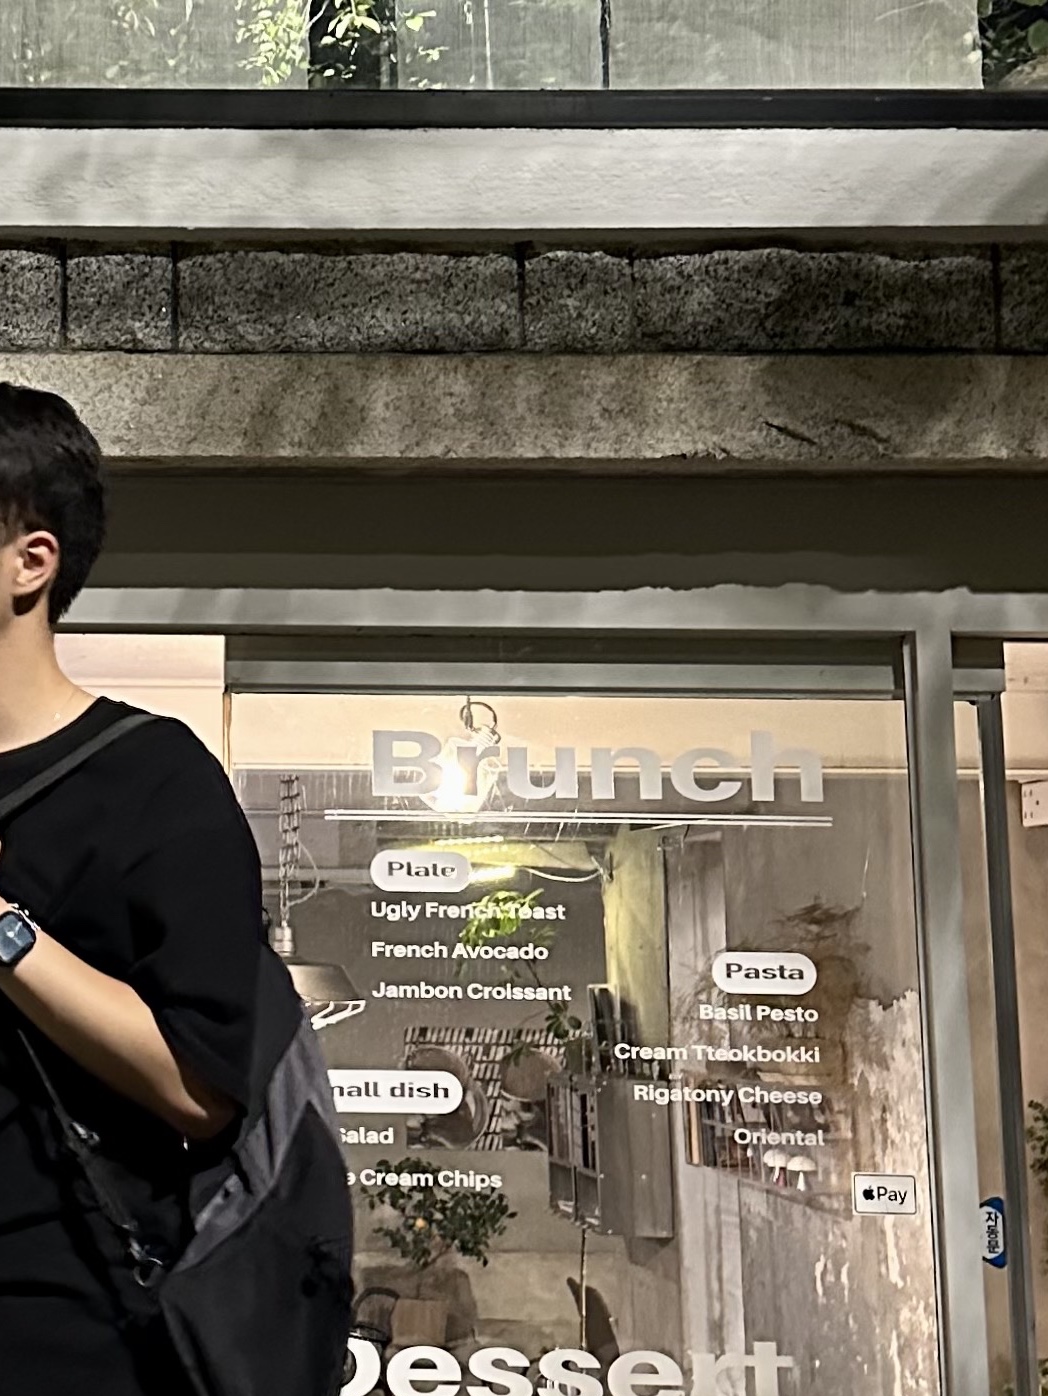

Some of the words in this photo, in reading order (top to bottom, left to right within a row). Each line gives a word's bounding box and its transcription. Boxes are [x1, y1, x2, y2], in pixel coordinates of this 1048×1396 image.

[372, 730, 824, 802] Brunch
[387, 860, 456, 878] Plate
[371, 901, 421, 921] Ugly
[425, 902, 501, 919] French
[508, 903, 566, 920] Toast
[371, 942, 448, 959] French
[452, 943, 549, 960] Avocado
[725, 963, 804, 980] Pasta
[371, 982, 463, 999] Jambon
[466, 983, 572, 1001] Croissant
[699, 1004, 752, 1020] Basil
[756, 1006, 819, 1022] Pesto
[614, 1043, 687, 1060] Cream
[692, 1045, 820, 1063] Tteokbokki
[332, 1082, 381, 1098] all
[389, 1082, 450, 1099] dish
[634, 1084, 734, 1106] Rigatony
[738, 1086, 822, 1104] Cheese
[734, 1128, 825, 1146] Oriental
[360, 1168, 434, 1187] Cream
[437, 1169, 503, 1191] Chips
[877, 1186, 908, 1205] Pay
[985, 1211, 1000, 1254] 자동문
